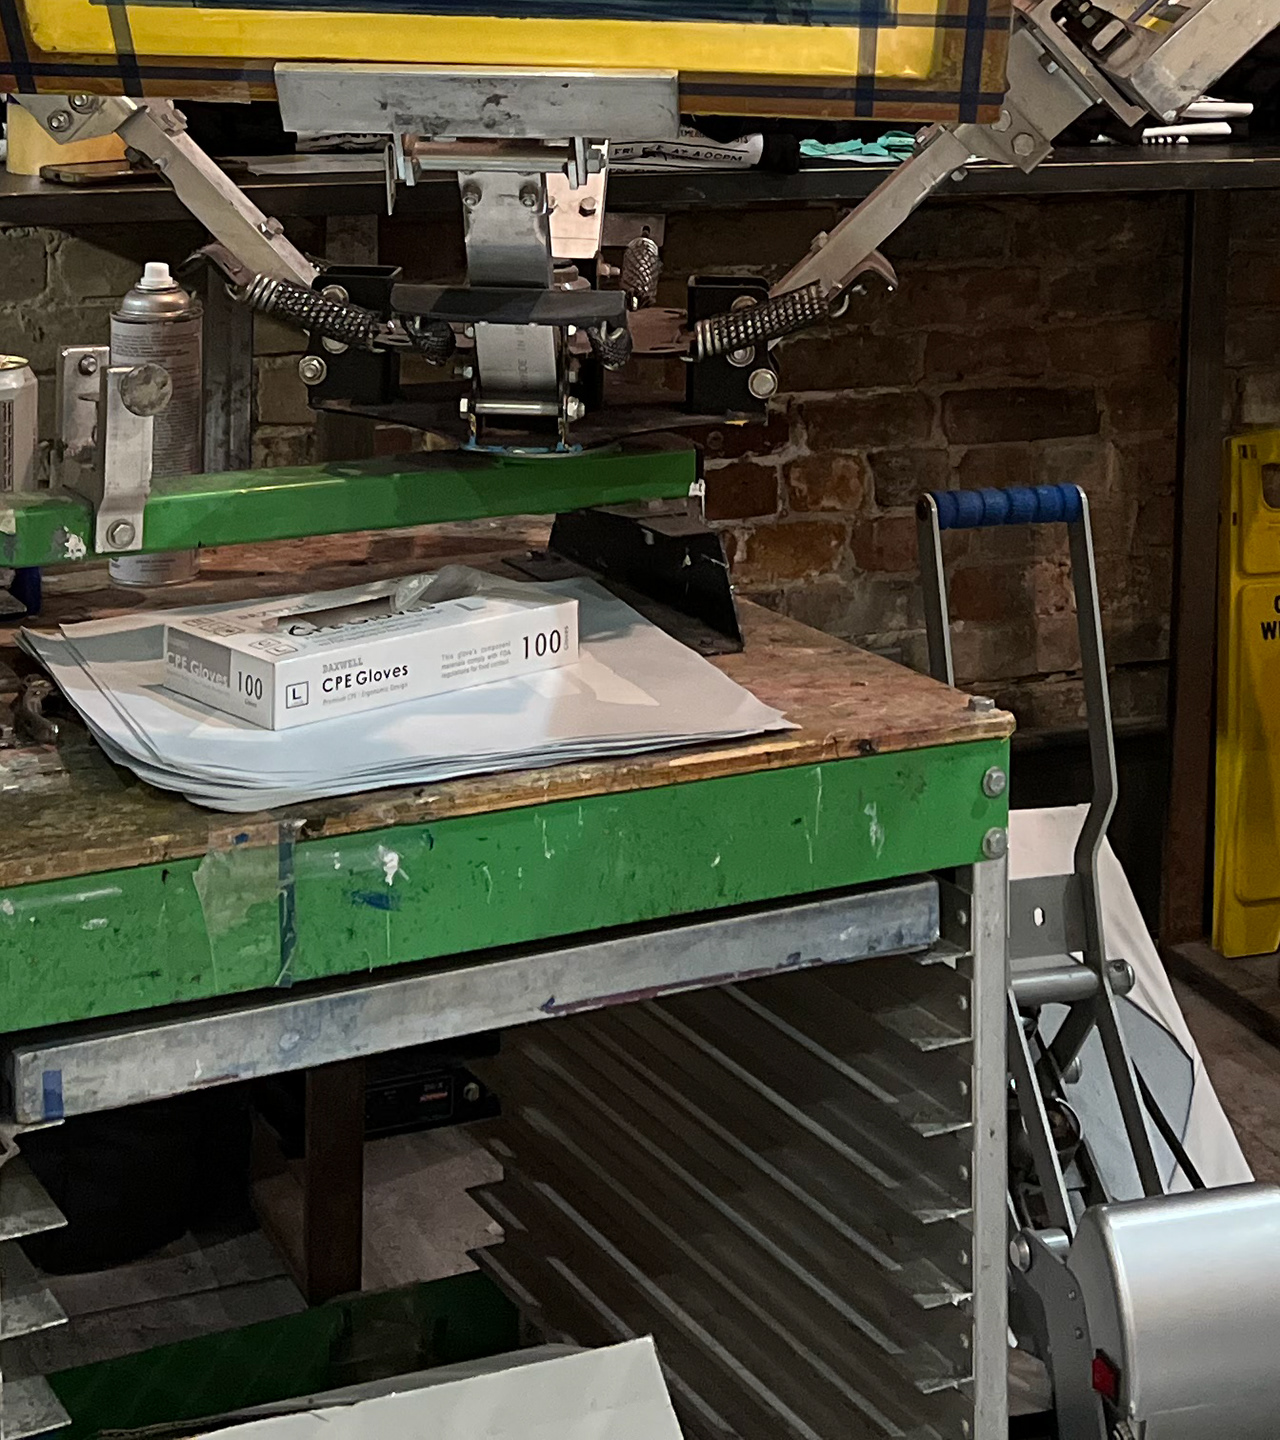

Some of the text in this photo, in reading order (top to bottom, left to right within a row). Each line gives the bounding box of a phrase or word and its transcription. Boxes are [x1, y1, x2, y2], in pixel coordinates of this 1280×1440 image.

[522, 630, 561, 660] 100
[167, 652, 188, 671] CPE
[190, 660, 228, 686] Gloves
[322, 664, 409, 693] CPE Gloves
[323, 658, 363, 674] DAXWELL
[238, 671, 263, 701] 100
[292, 688, 301, 700] L
